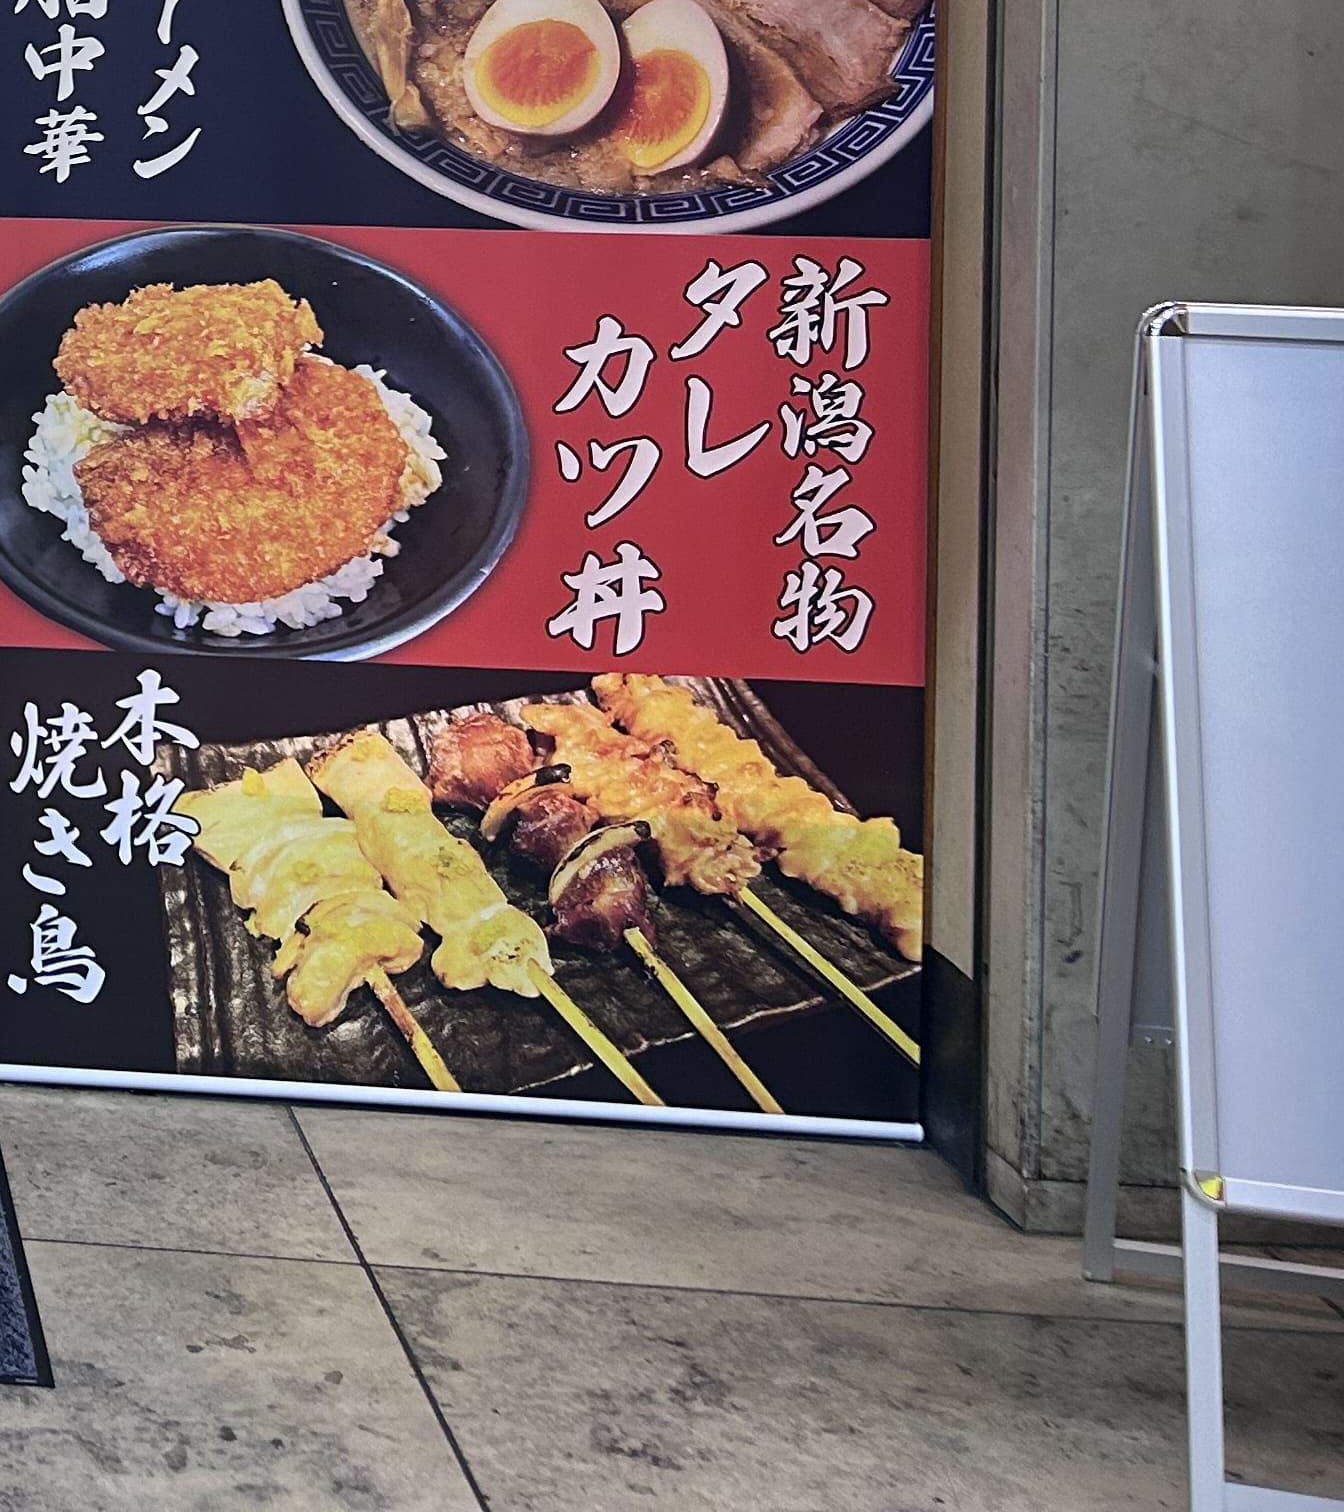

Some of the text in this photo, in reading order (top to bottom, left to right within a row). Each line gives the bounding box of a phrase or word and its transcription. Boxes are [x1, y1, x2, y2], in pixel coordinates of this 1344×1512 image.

[547, 315, 665, 656] カツ丼
[669, 259, 773, 478] タレ
[767, 255, 889, 654] 新潟名物
[6, 700, 109, 1006] 焼き鳥
[99, 668, 205, 868] 本格
